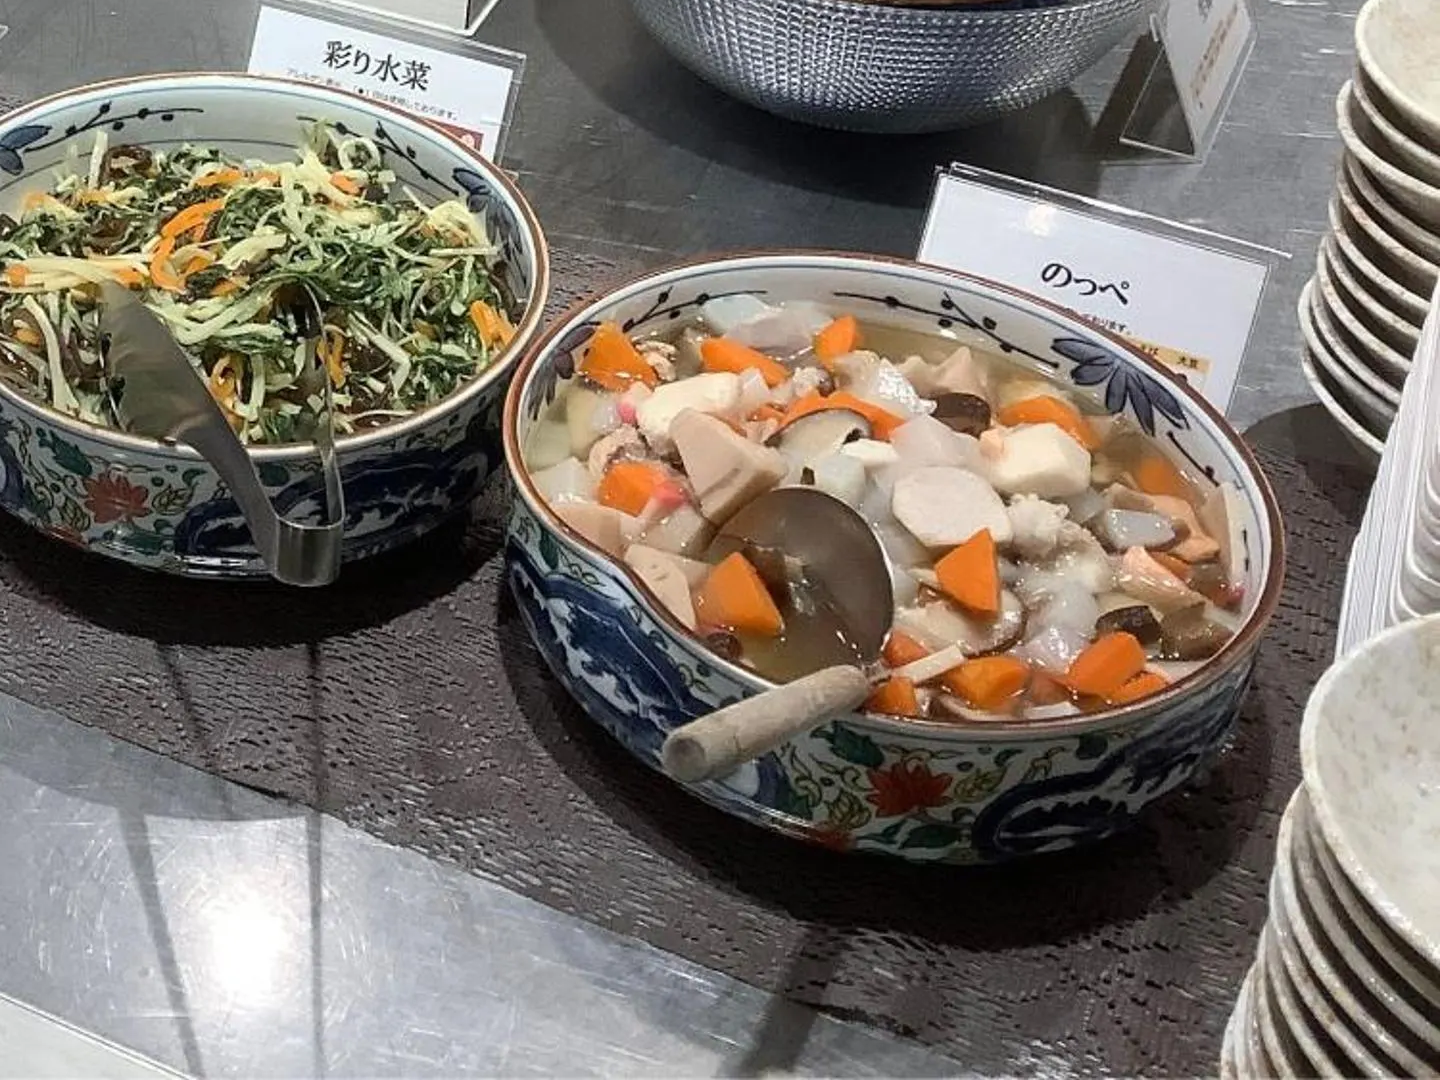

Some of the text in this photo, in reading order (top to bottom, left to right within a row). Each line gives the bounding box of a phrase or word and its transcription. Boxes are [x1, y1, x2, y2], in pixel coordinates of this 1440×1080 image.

[323, 40, 433, 91] 彩り水菜
[1040, 262, 1131, 306] のっぺ
